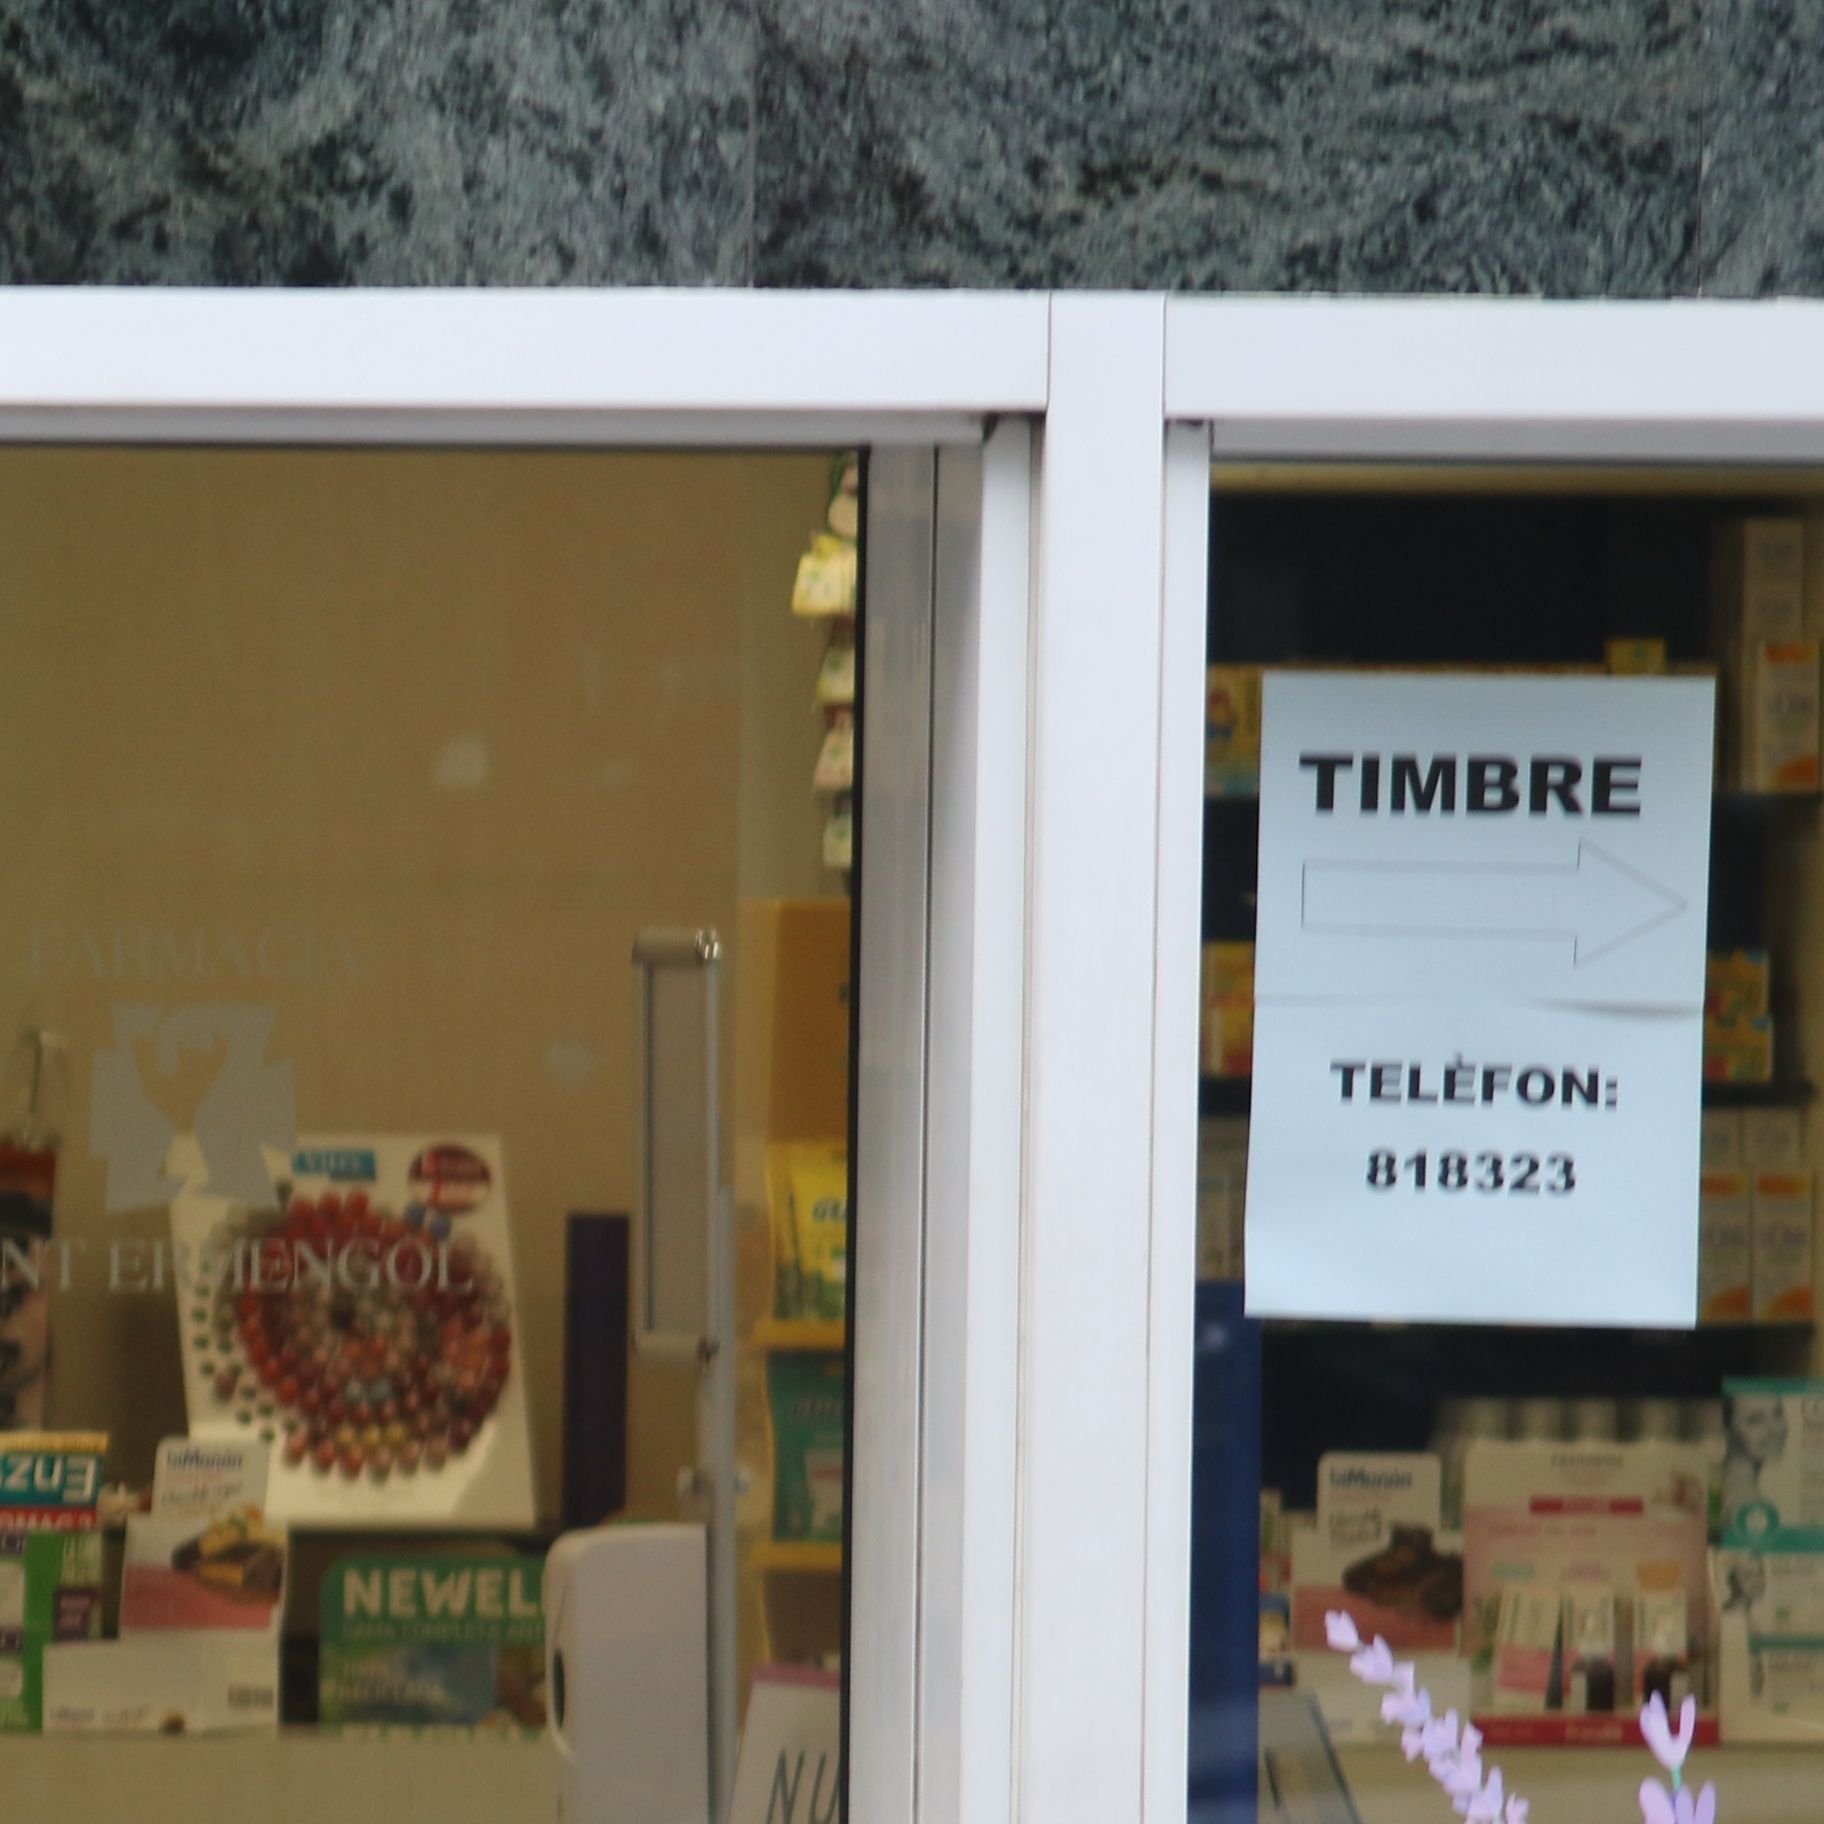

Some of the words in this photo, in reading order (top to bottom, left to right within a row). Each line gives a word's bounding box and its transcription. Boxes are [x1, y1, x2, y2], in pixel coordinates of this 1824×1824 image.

[1299, 753, 1642, 818] TIMBRE
[1365, 1148, 1577, 1195] 818323
[108, 1238, 476, 1295] ERMENGOL
